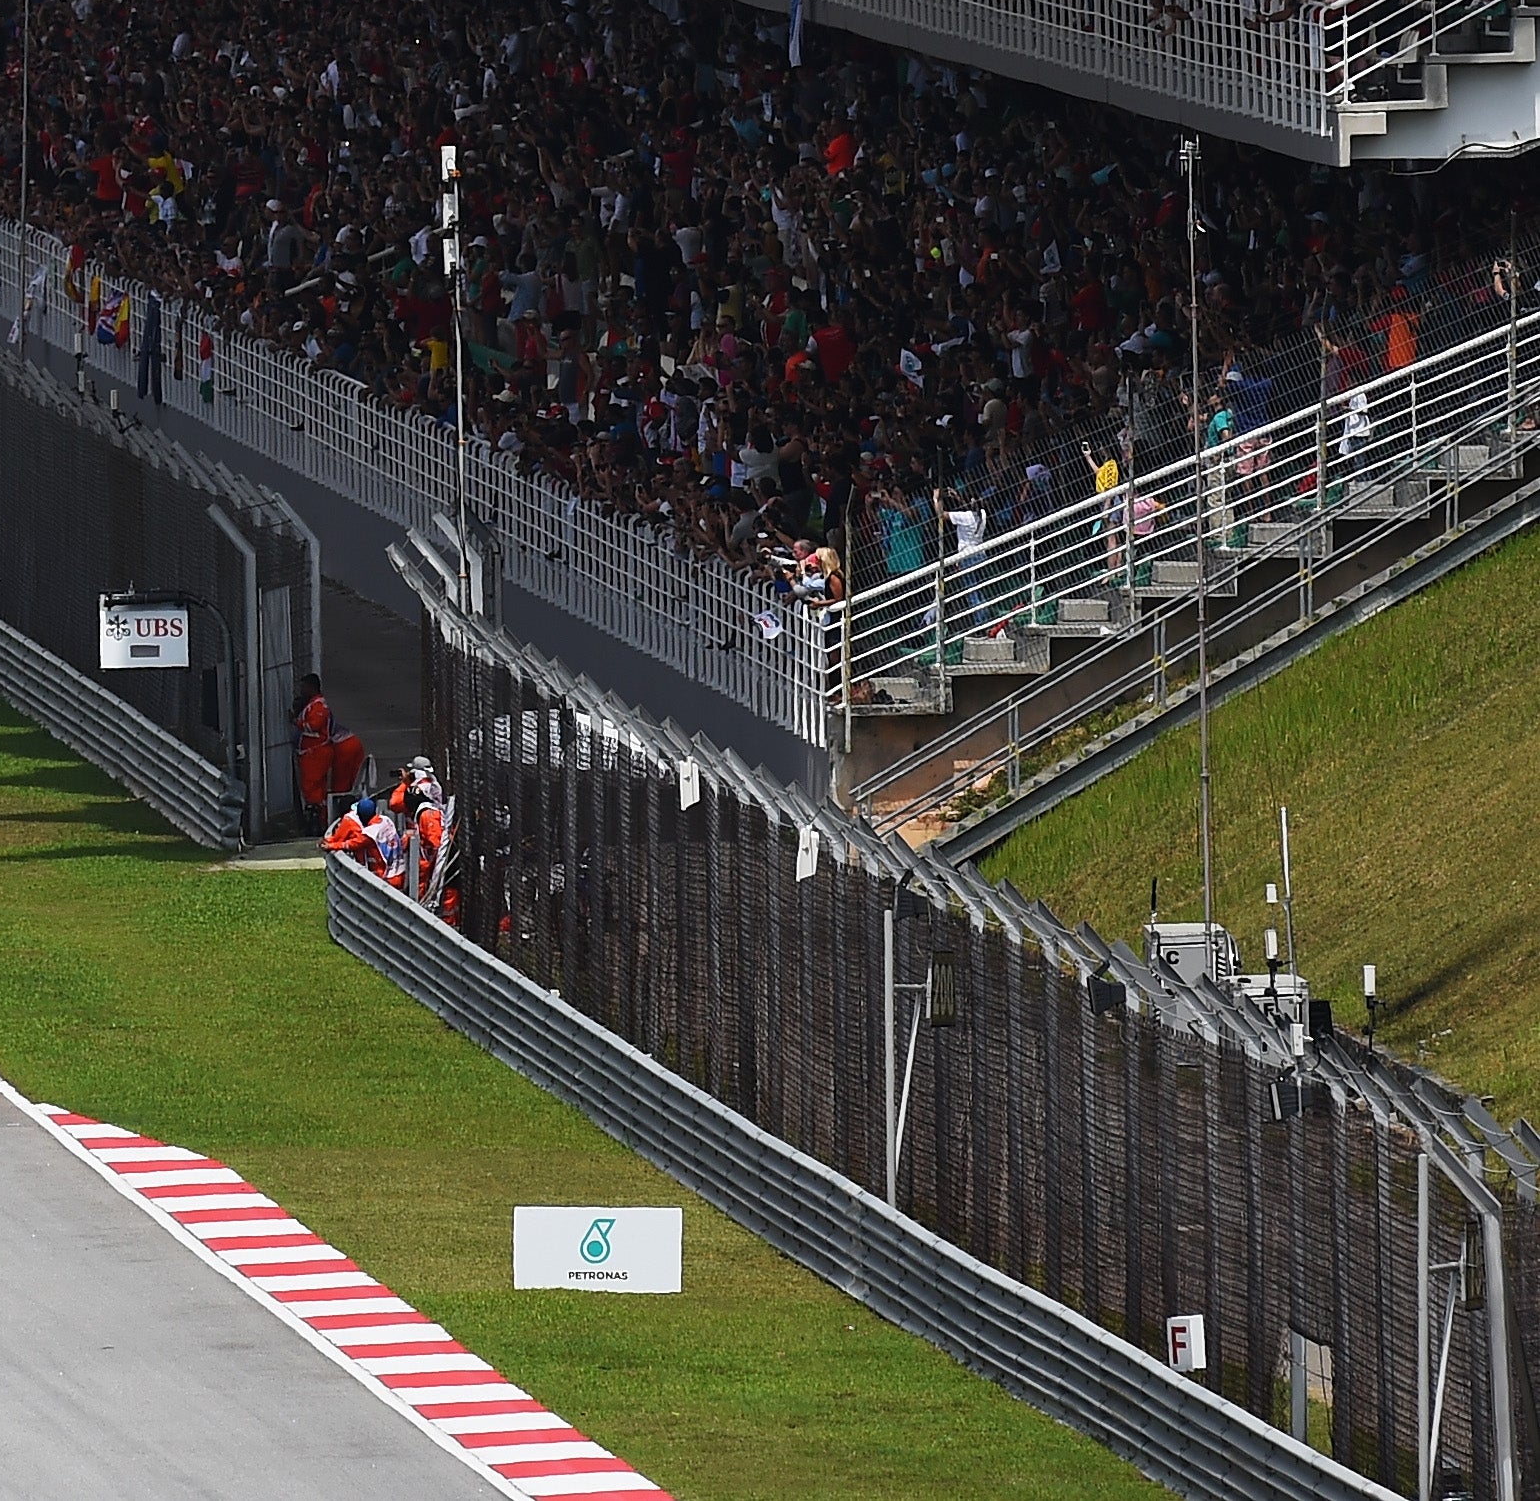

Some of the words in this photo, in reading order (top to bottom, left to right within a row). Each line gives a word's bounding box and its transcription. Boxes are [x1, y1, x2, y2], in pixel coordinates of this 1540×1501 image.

[135, 617, 184, 638] UBS
[1165, 950, 1180, 965] C
[568, 1271, 628, 1280] PETRONAS
[1170, 1326, 1187, 1365] F
